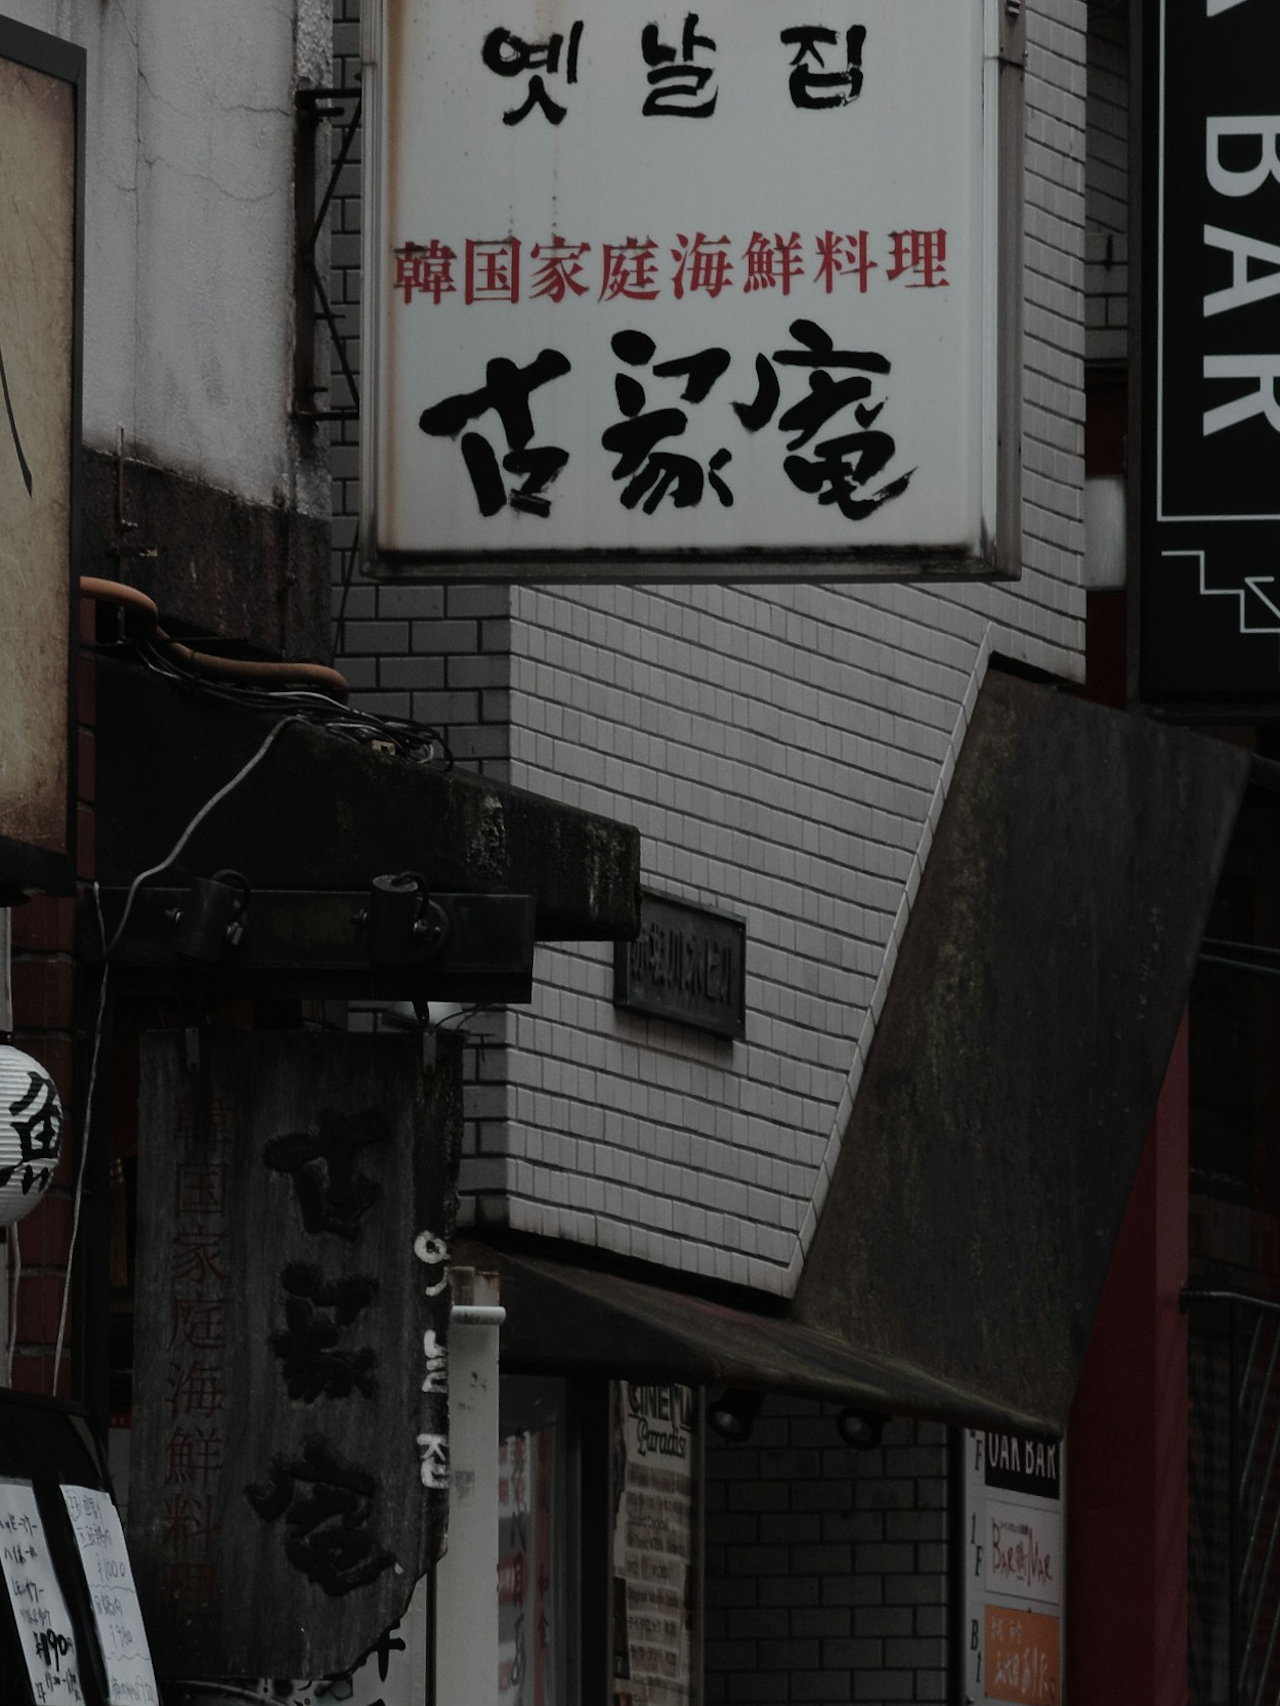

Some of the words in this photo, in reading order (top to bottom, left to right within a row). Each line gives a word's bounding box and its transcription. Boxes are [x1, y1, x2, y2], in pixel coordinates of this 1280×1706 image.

[394, 227, 950, 306] 韓国家庭海鮮料理
